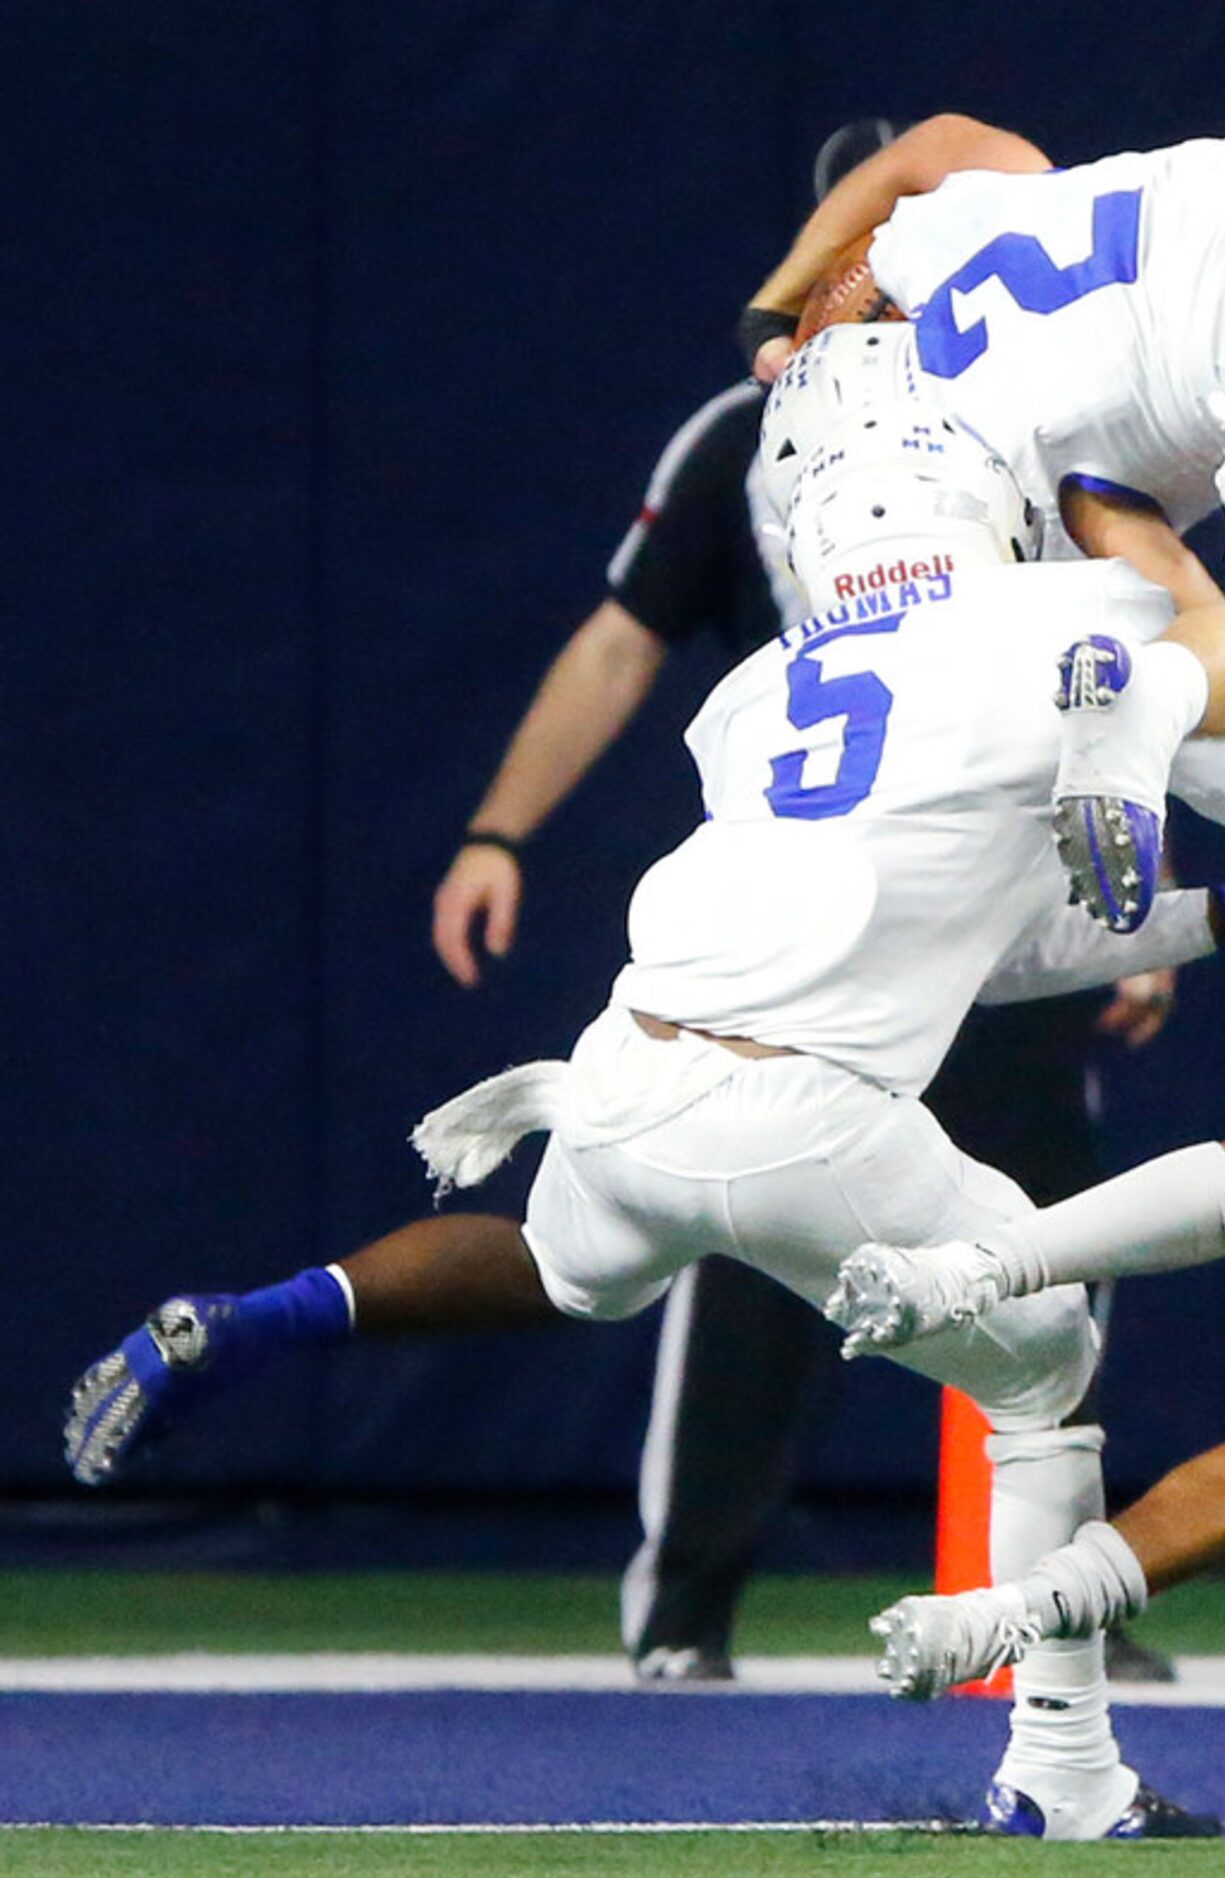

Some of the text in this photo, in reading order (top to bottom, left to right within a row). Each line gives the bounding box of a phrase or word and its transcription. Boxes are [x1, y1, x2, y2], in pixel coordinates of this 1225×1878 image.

[915, 186, 1144, 380] 2
[834, 554, 955, 601] Riddell
[763, 612, 908, 821] 5
